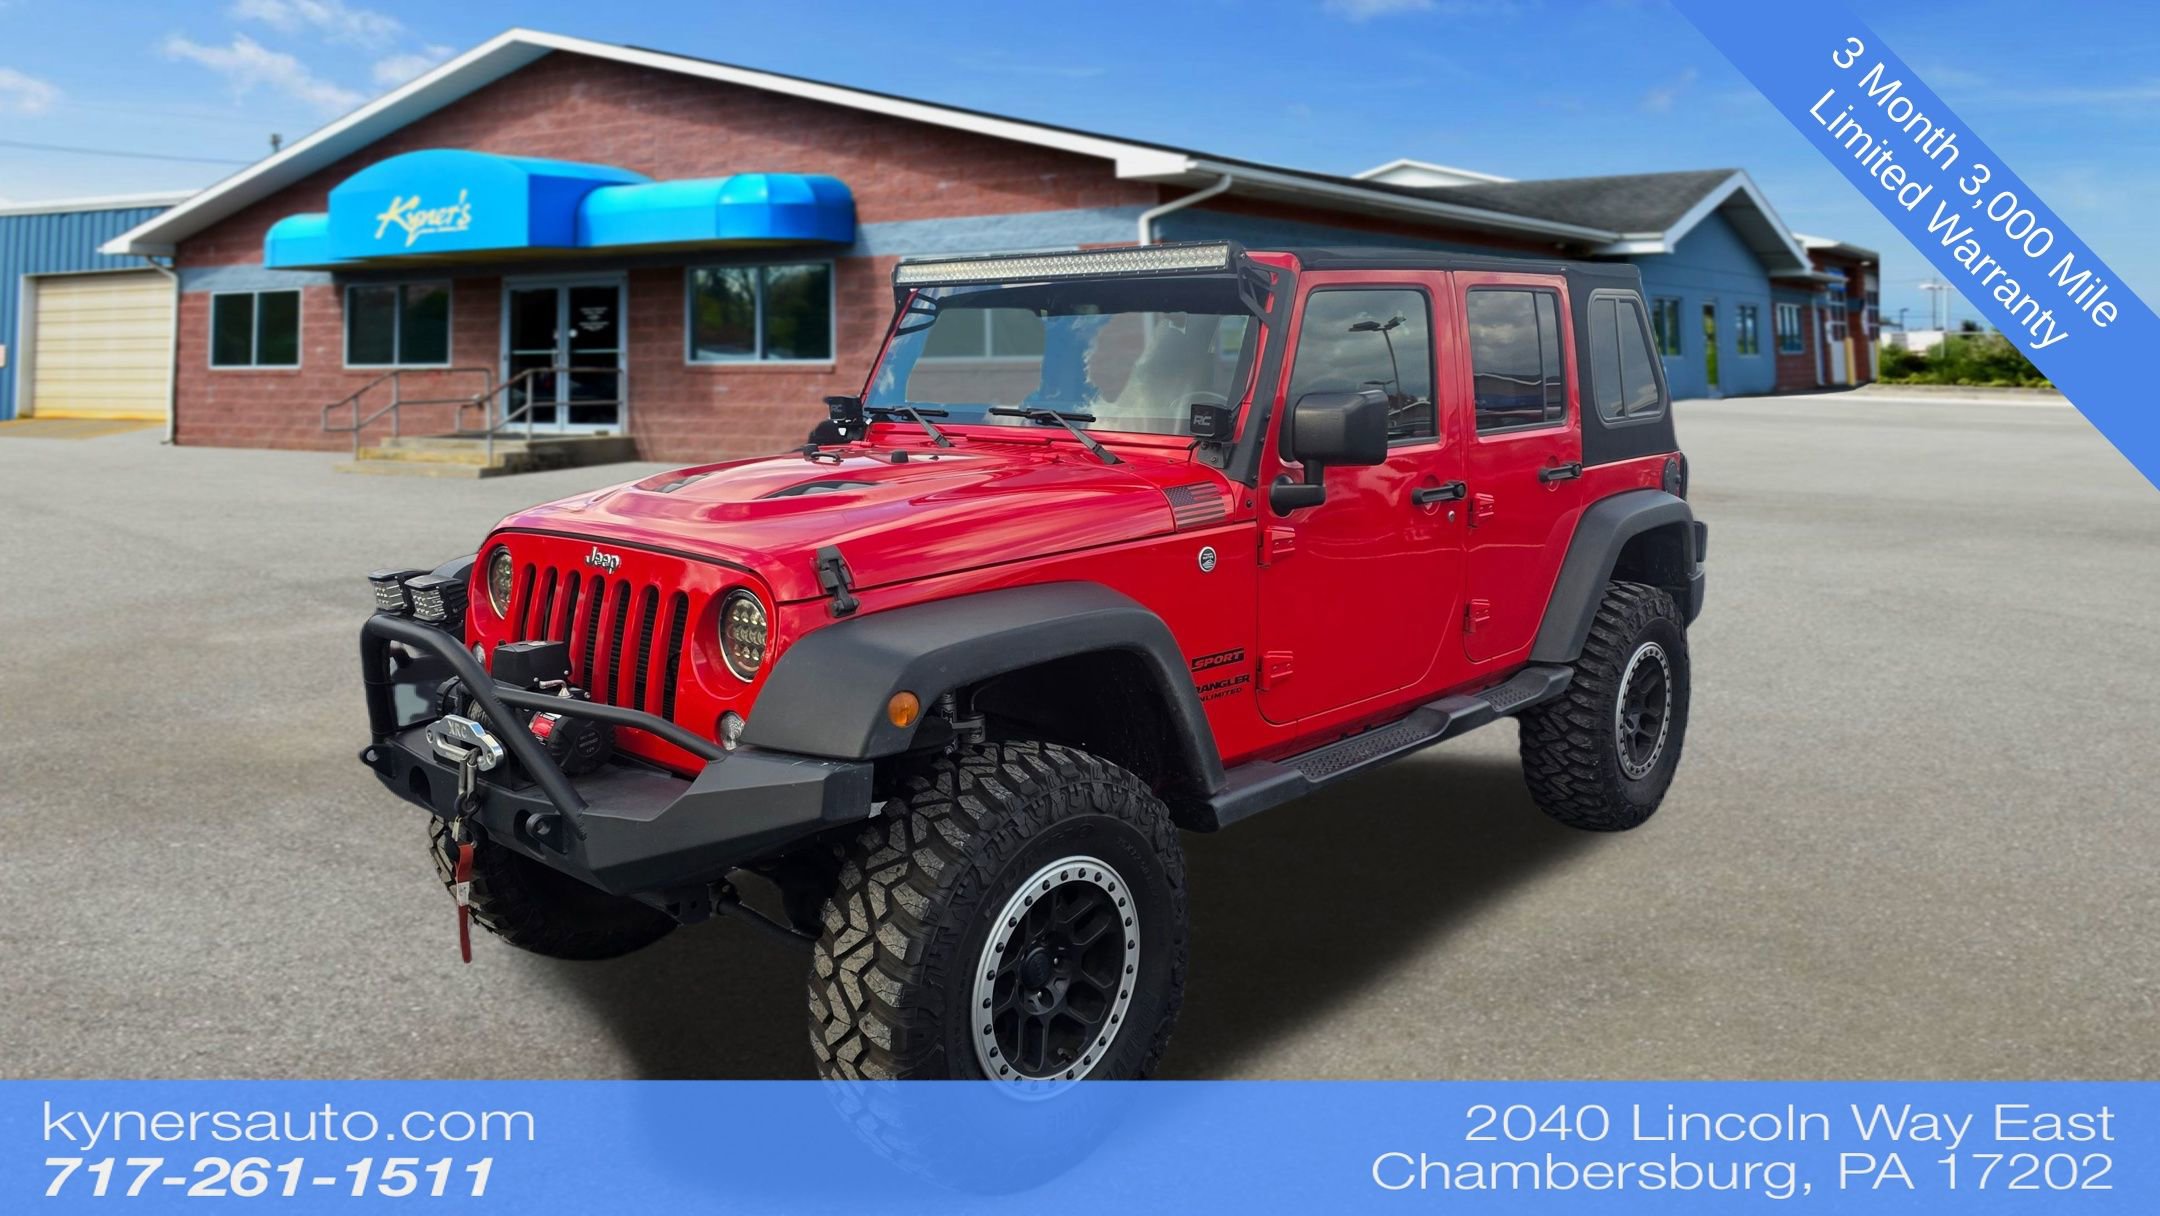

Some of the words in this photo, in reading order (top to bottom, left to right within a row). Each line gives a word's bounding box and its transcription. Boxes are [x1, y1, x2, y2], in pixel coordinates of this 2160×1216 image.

[375, 189, 472, 247] Kyner's
[1193, 415, 1212, 426] RC
[585, 546, 620, 575] Jeep
[1193, 650, 1243, 668] SPORT
[1195, 674, 1250, 694] RANGLER
[1200, 687, 1242, 702] NLIMITED
[447, 719, 468, 739] XRC
